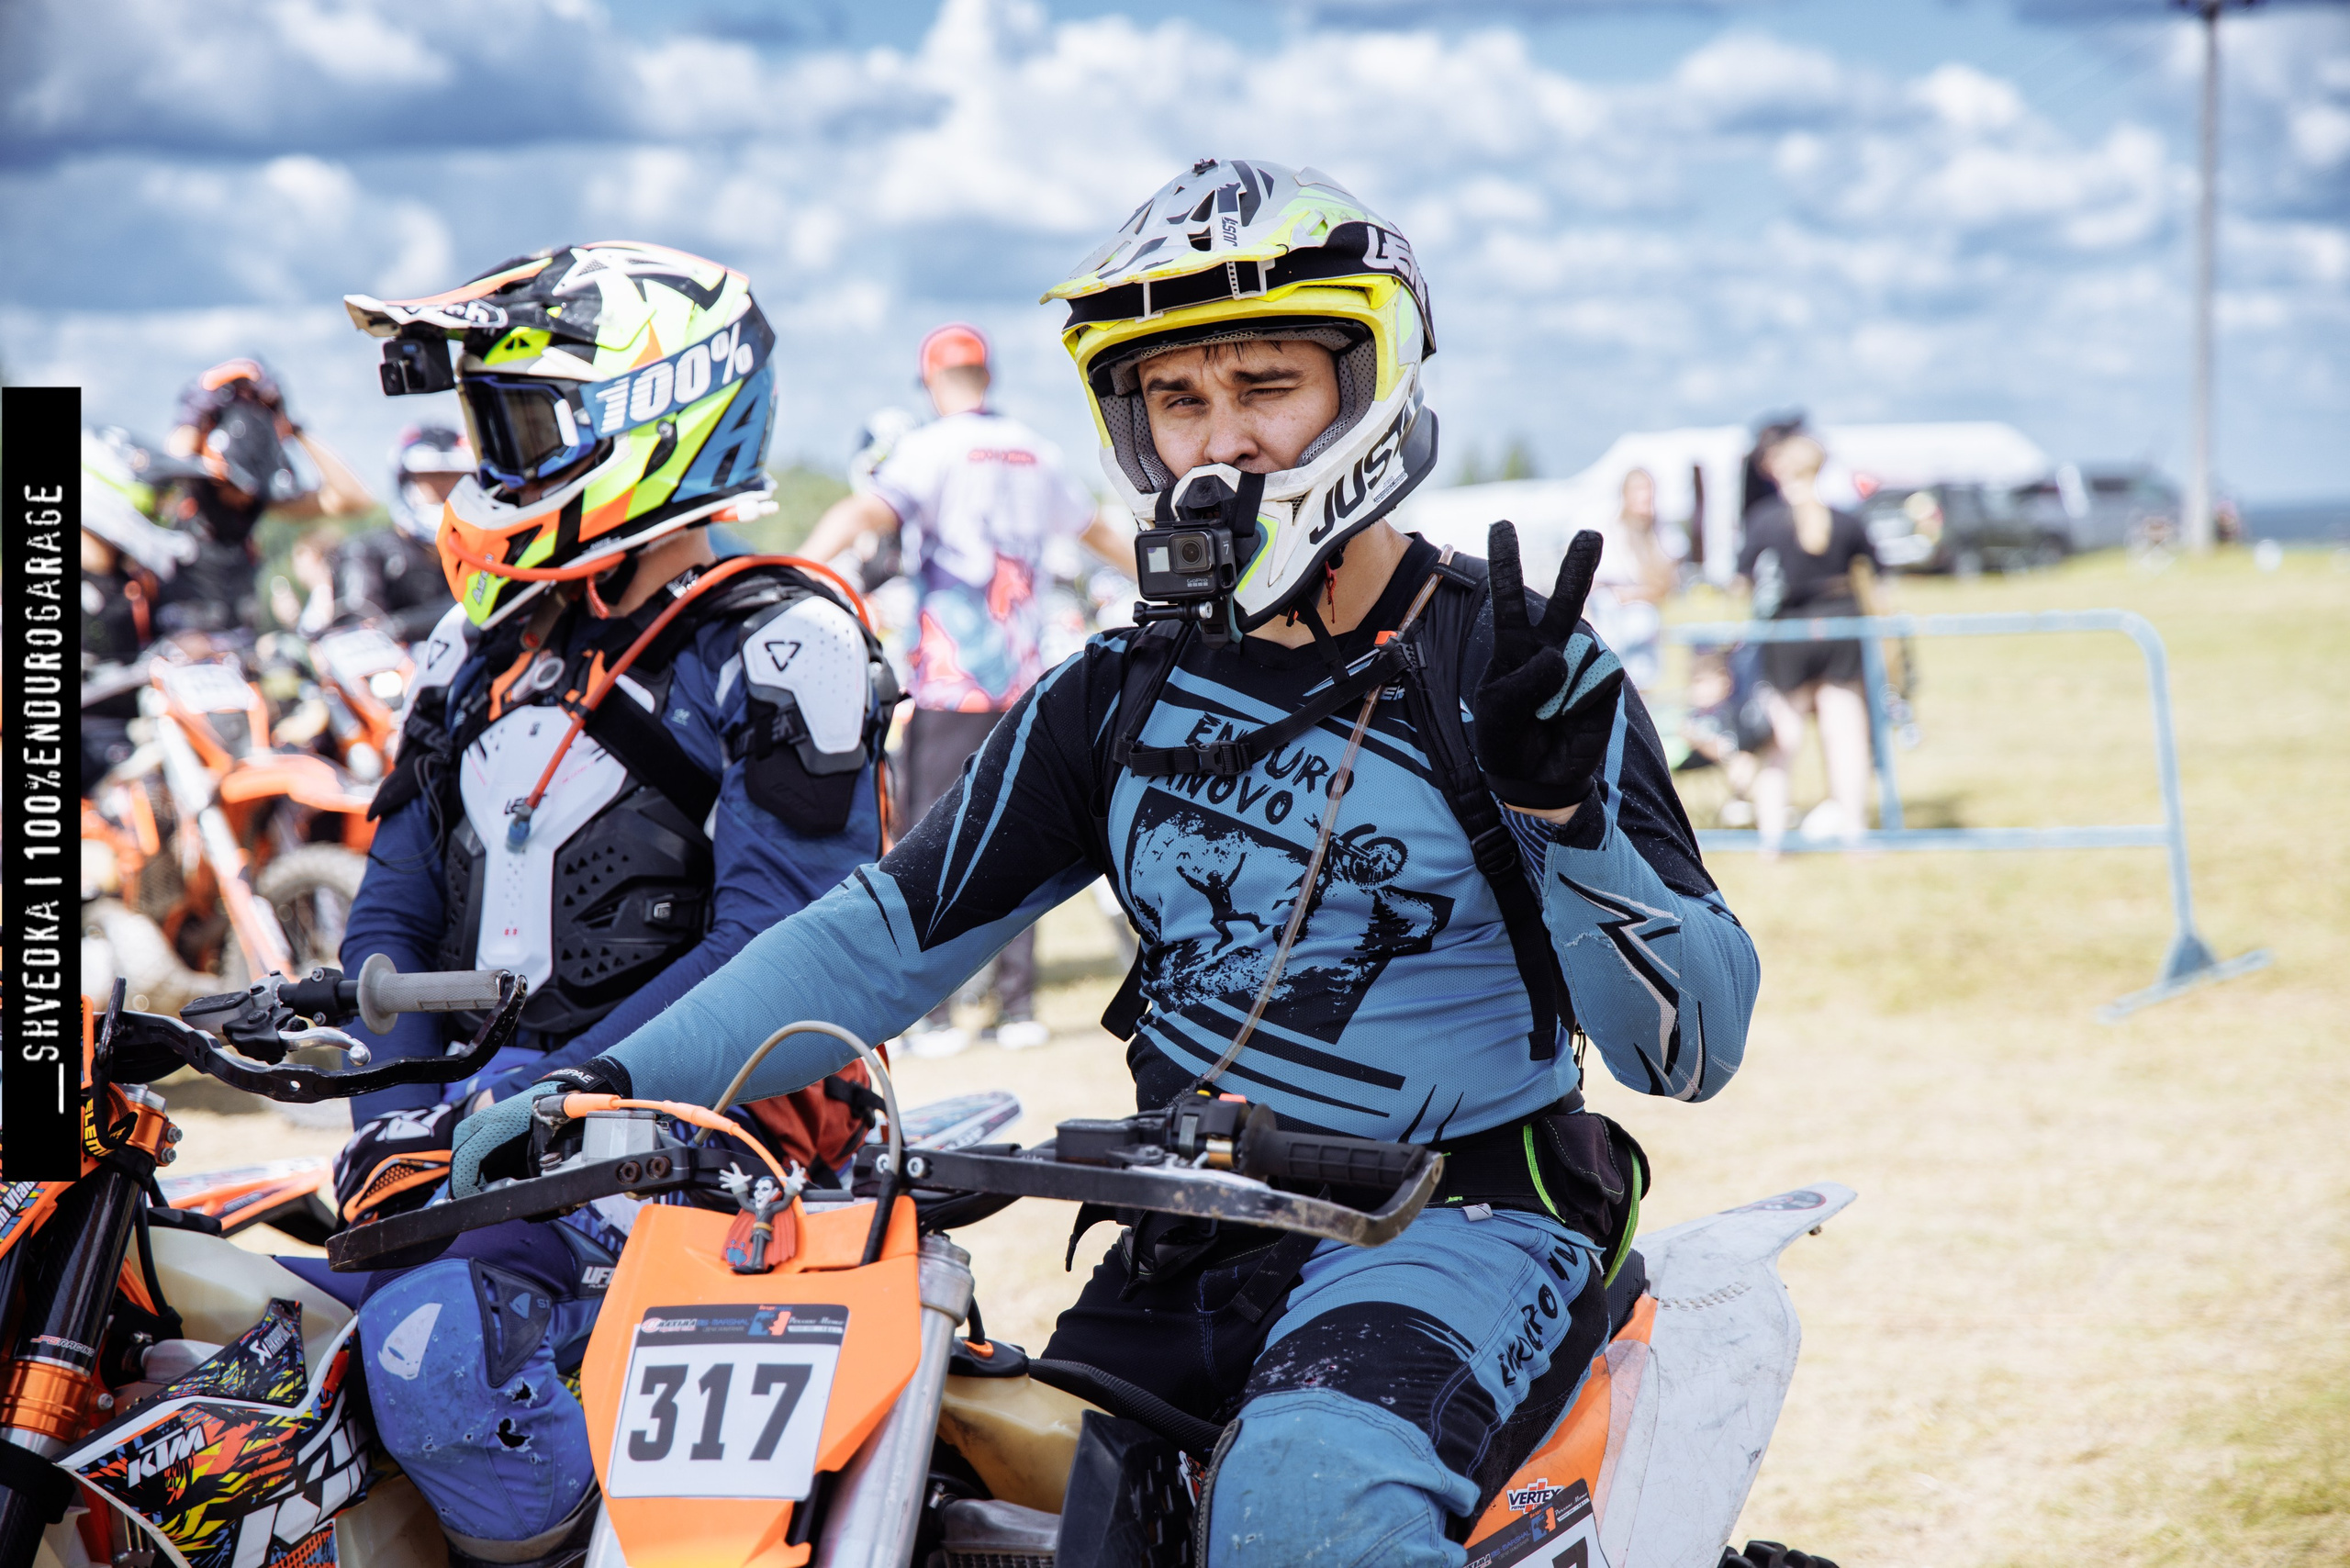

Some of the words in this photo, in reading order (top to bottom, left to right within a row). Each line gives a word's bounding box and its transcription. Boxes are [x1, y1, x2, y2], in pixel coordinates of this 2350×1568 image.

[595, 321, 755, 435] 100%
[128, 1424, 207, 1489] KTM
[628, 1362, 812, 1462] 317
